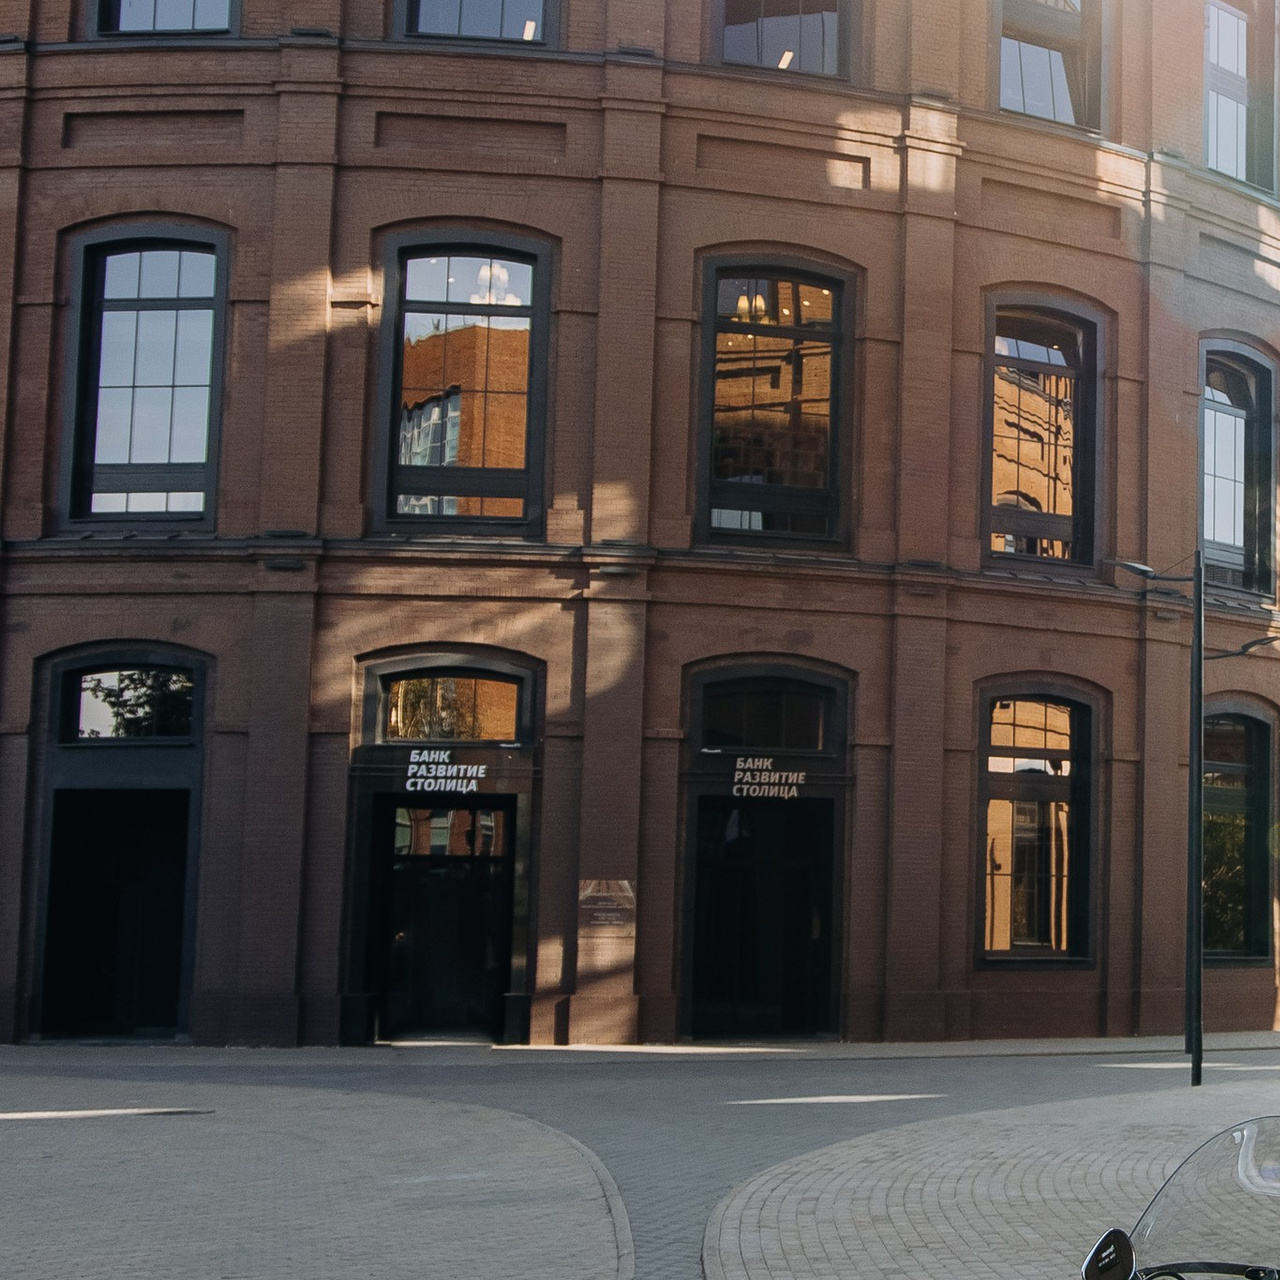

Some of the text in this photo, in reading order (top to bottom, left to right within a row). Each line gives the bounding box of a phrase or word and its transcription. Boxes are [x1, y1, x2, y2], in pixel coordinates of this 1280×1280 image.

[410, 750, 450, 762] БАНК
[735, 757, 773, 769] БАНК
[407, 764, 487, 777] РАЗВИТИЕ
[734, 771, 806, 784] РАЗВИТИЕ
[405, 778, 478, 794] СТОЛИЦА
[732, 784, 798, 800] СТОЛИЦА
